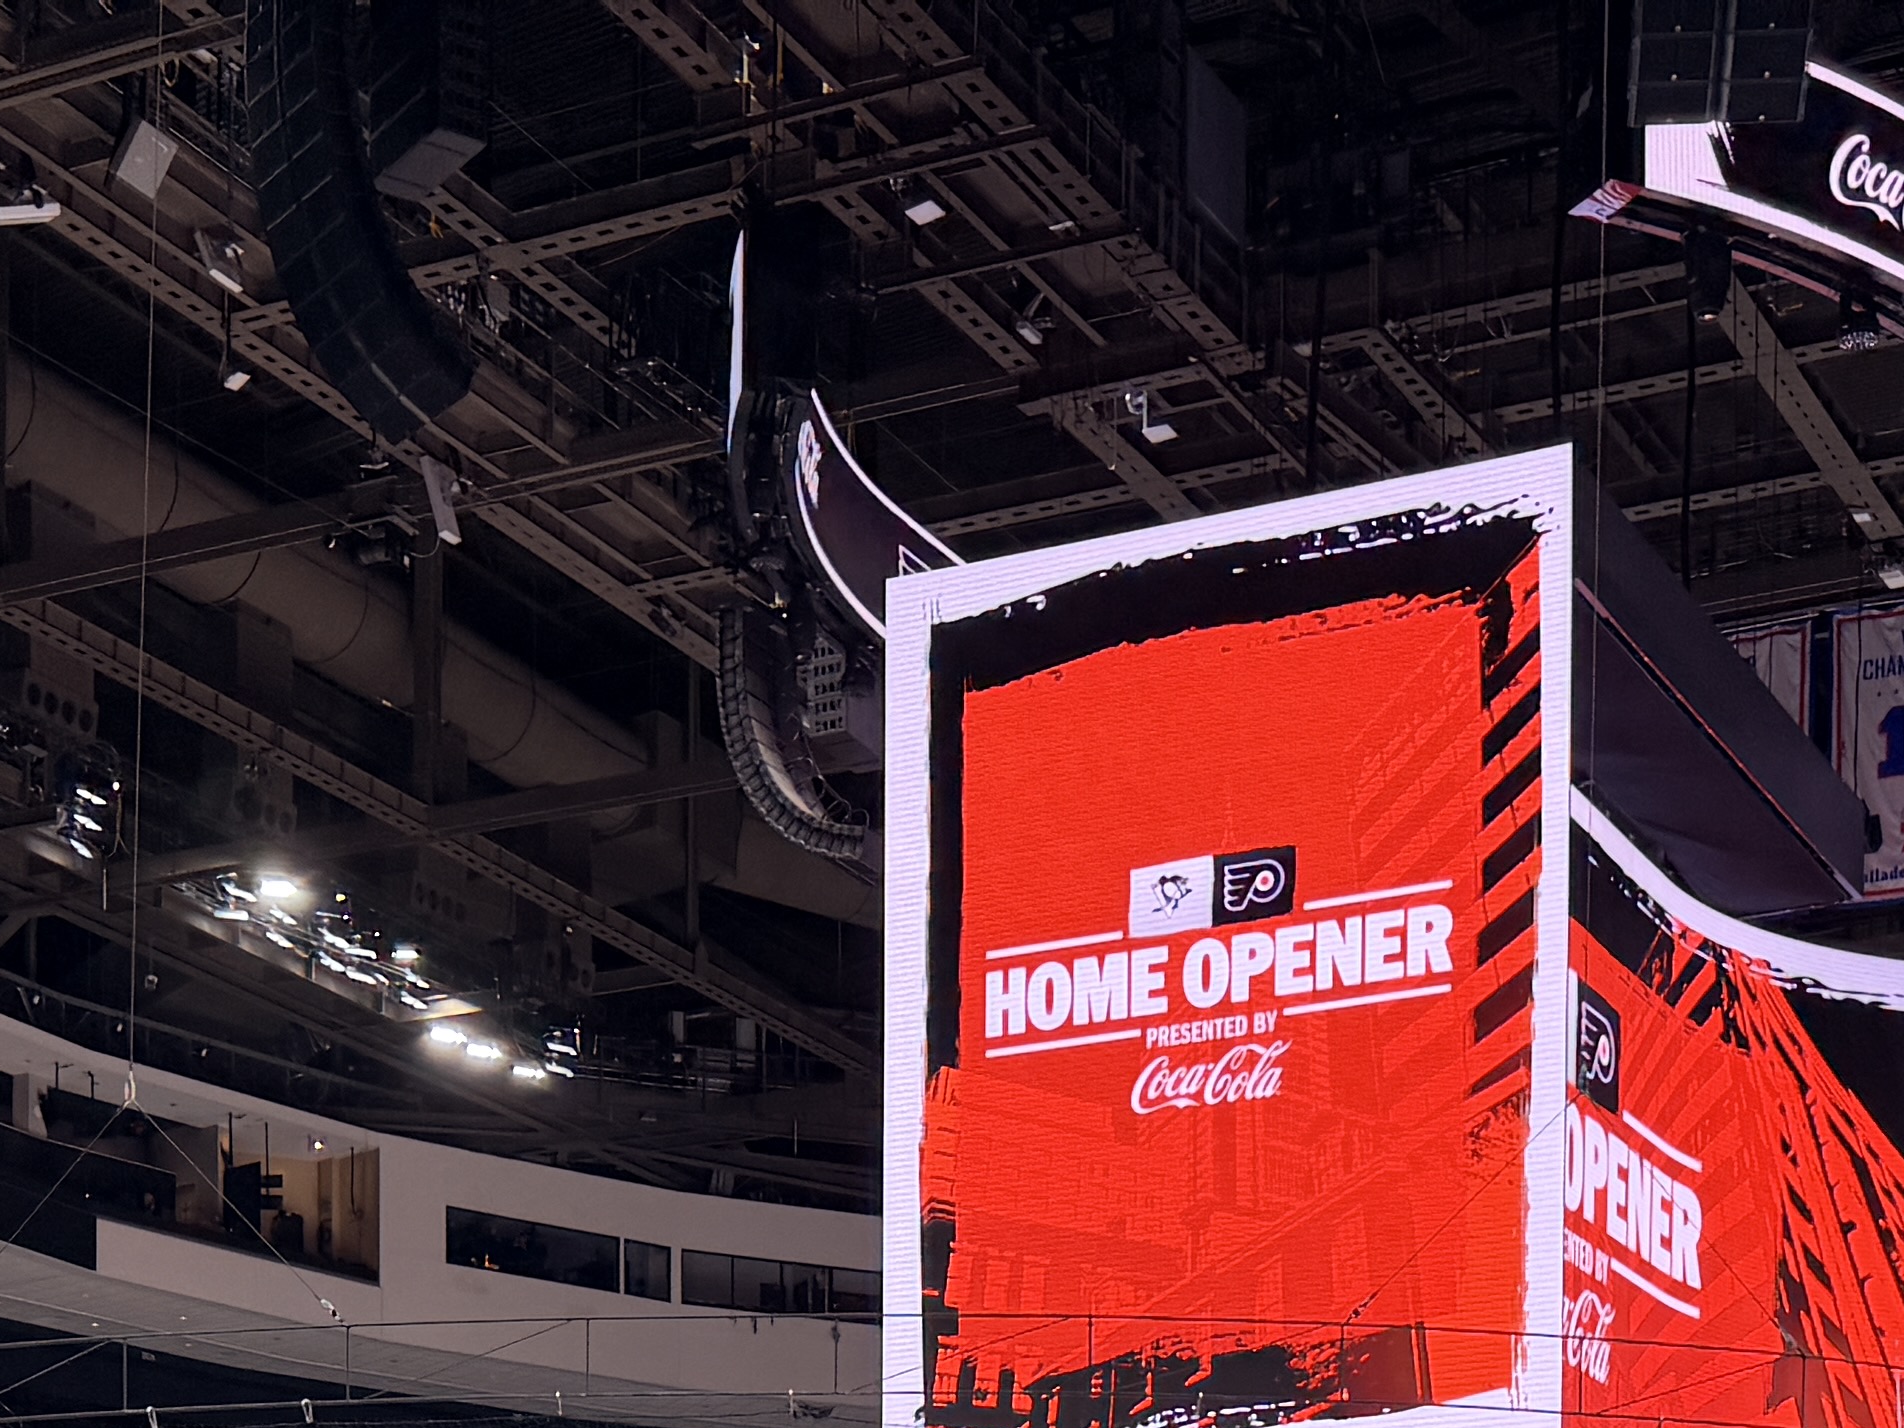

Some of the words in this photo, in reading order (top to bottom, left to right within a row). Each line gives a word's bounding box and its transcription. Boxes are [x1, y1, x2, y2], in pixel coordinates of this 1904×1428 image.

[985, 945, 1169, 1039] HOME
[1182, 904, 1454, 1009] OPENER
[1130, 1040, 1292, 1115] Coca-Cola
[1146, 1014, 1248, 1049] PRESENTED
[1253, 1010, 1279, 1036] BY
[1564, 1103, 1702, 1290] OPENER
